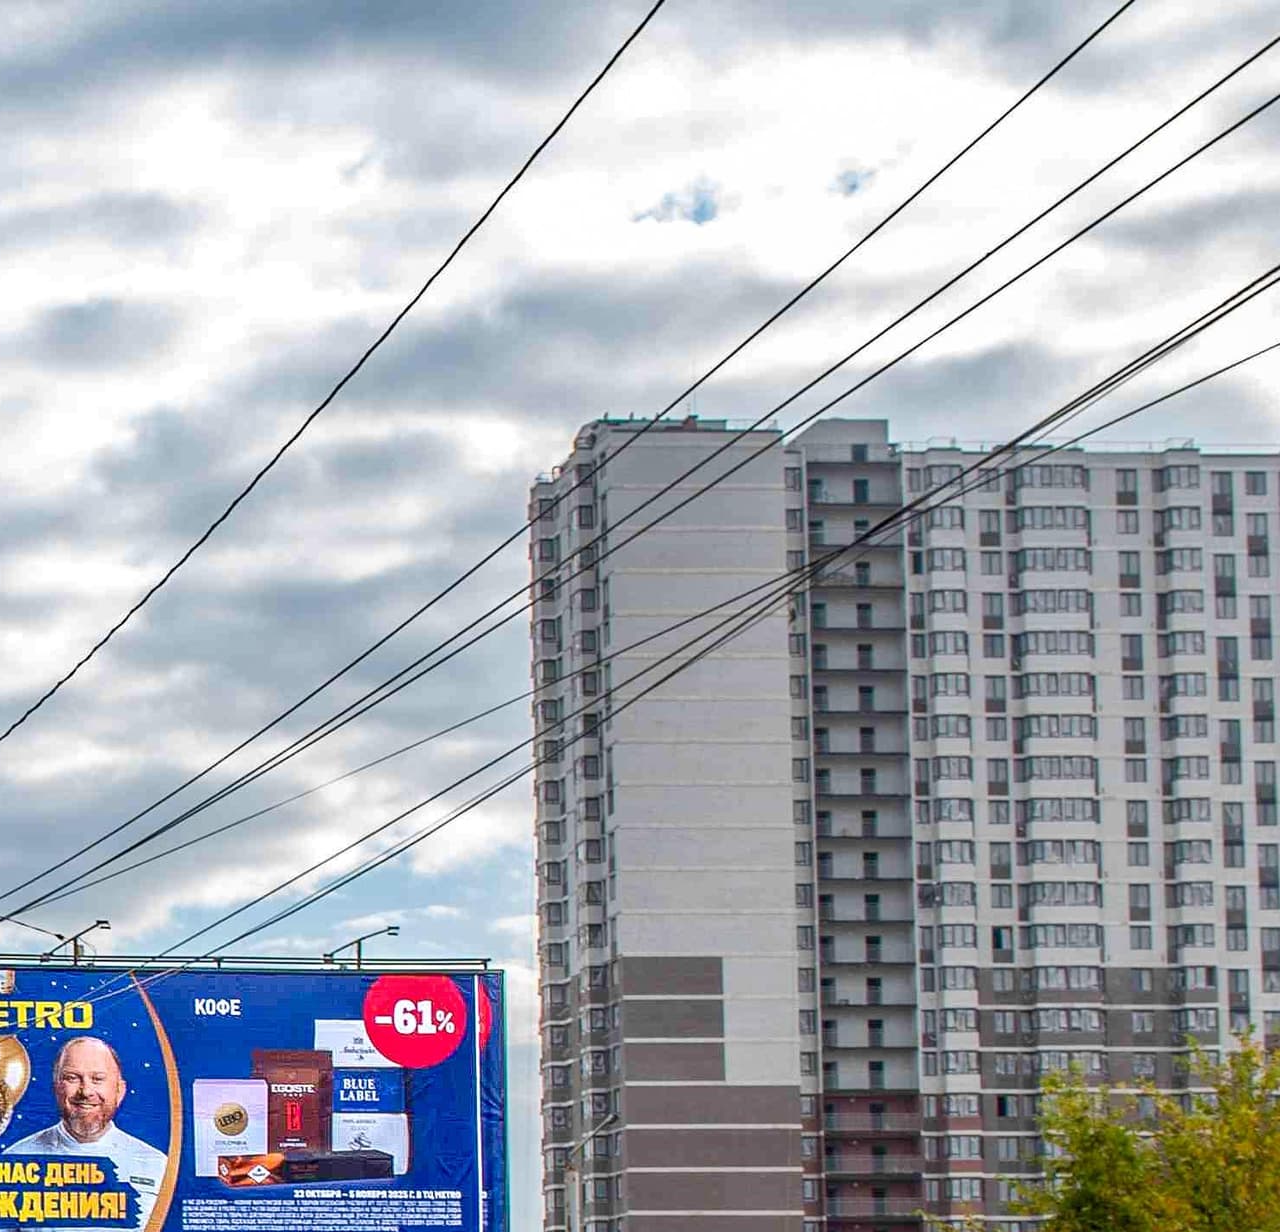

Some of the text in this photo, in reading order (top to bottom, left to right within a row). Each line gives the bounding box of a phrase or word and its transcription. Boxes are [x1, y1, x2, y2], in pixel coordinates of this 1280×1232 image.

[194, 998, 241, 1016] КОФЕ
[343, 1078, 376, 1090] BLUE
[339, 1090, 380, 1102] LABEL
[44, 1162, 105, 1186] ДЕНЬ
